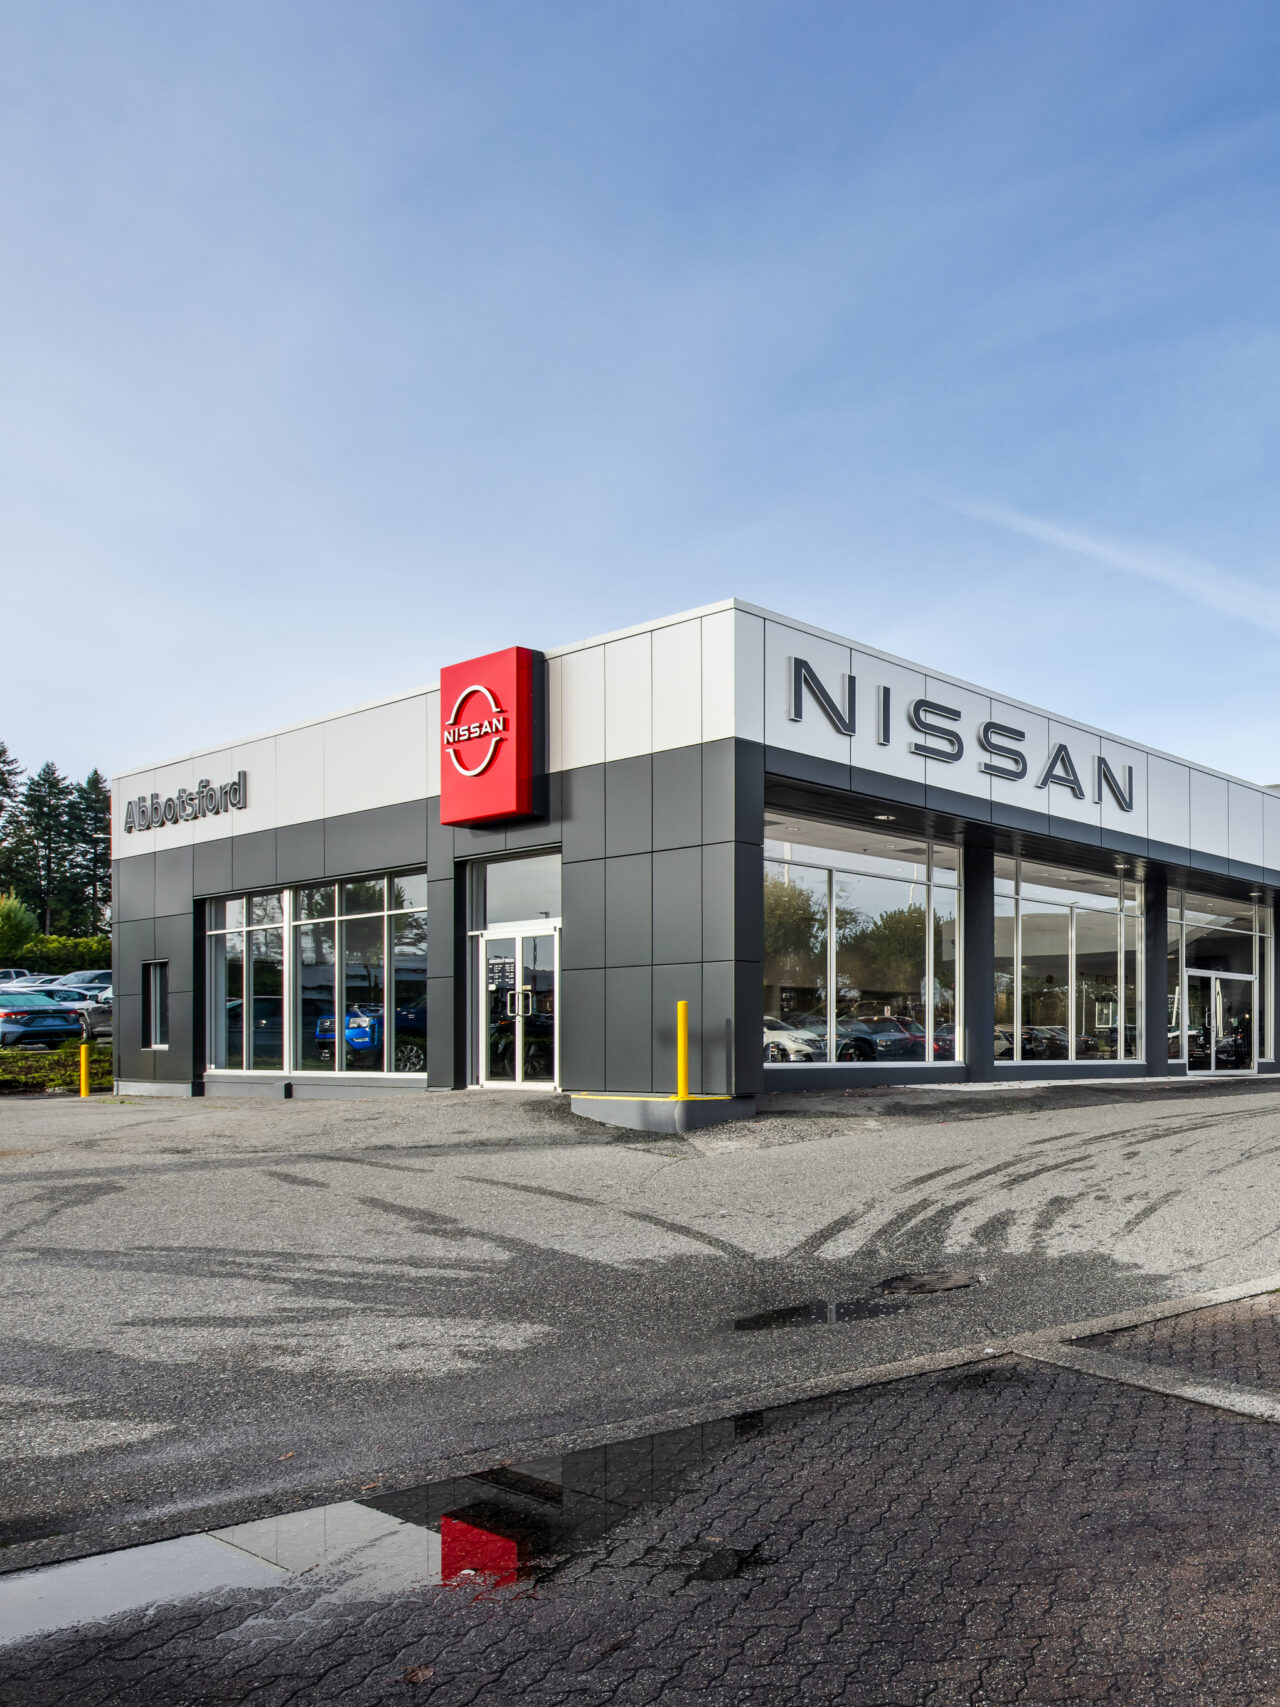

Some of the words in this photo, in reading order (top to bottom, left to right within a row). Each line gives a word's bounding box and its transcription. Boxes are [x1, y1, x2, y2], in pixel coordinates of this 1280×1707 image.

[444, 716, 504, 745] NISSAN
[788, 655, 1134, 812] NISSAN
[124, 769, 247, 833] Abbotsford
